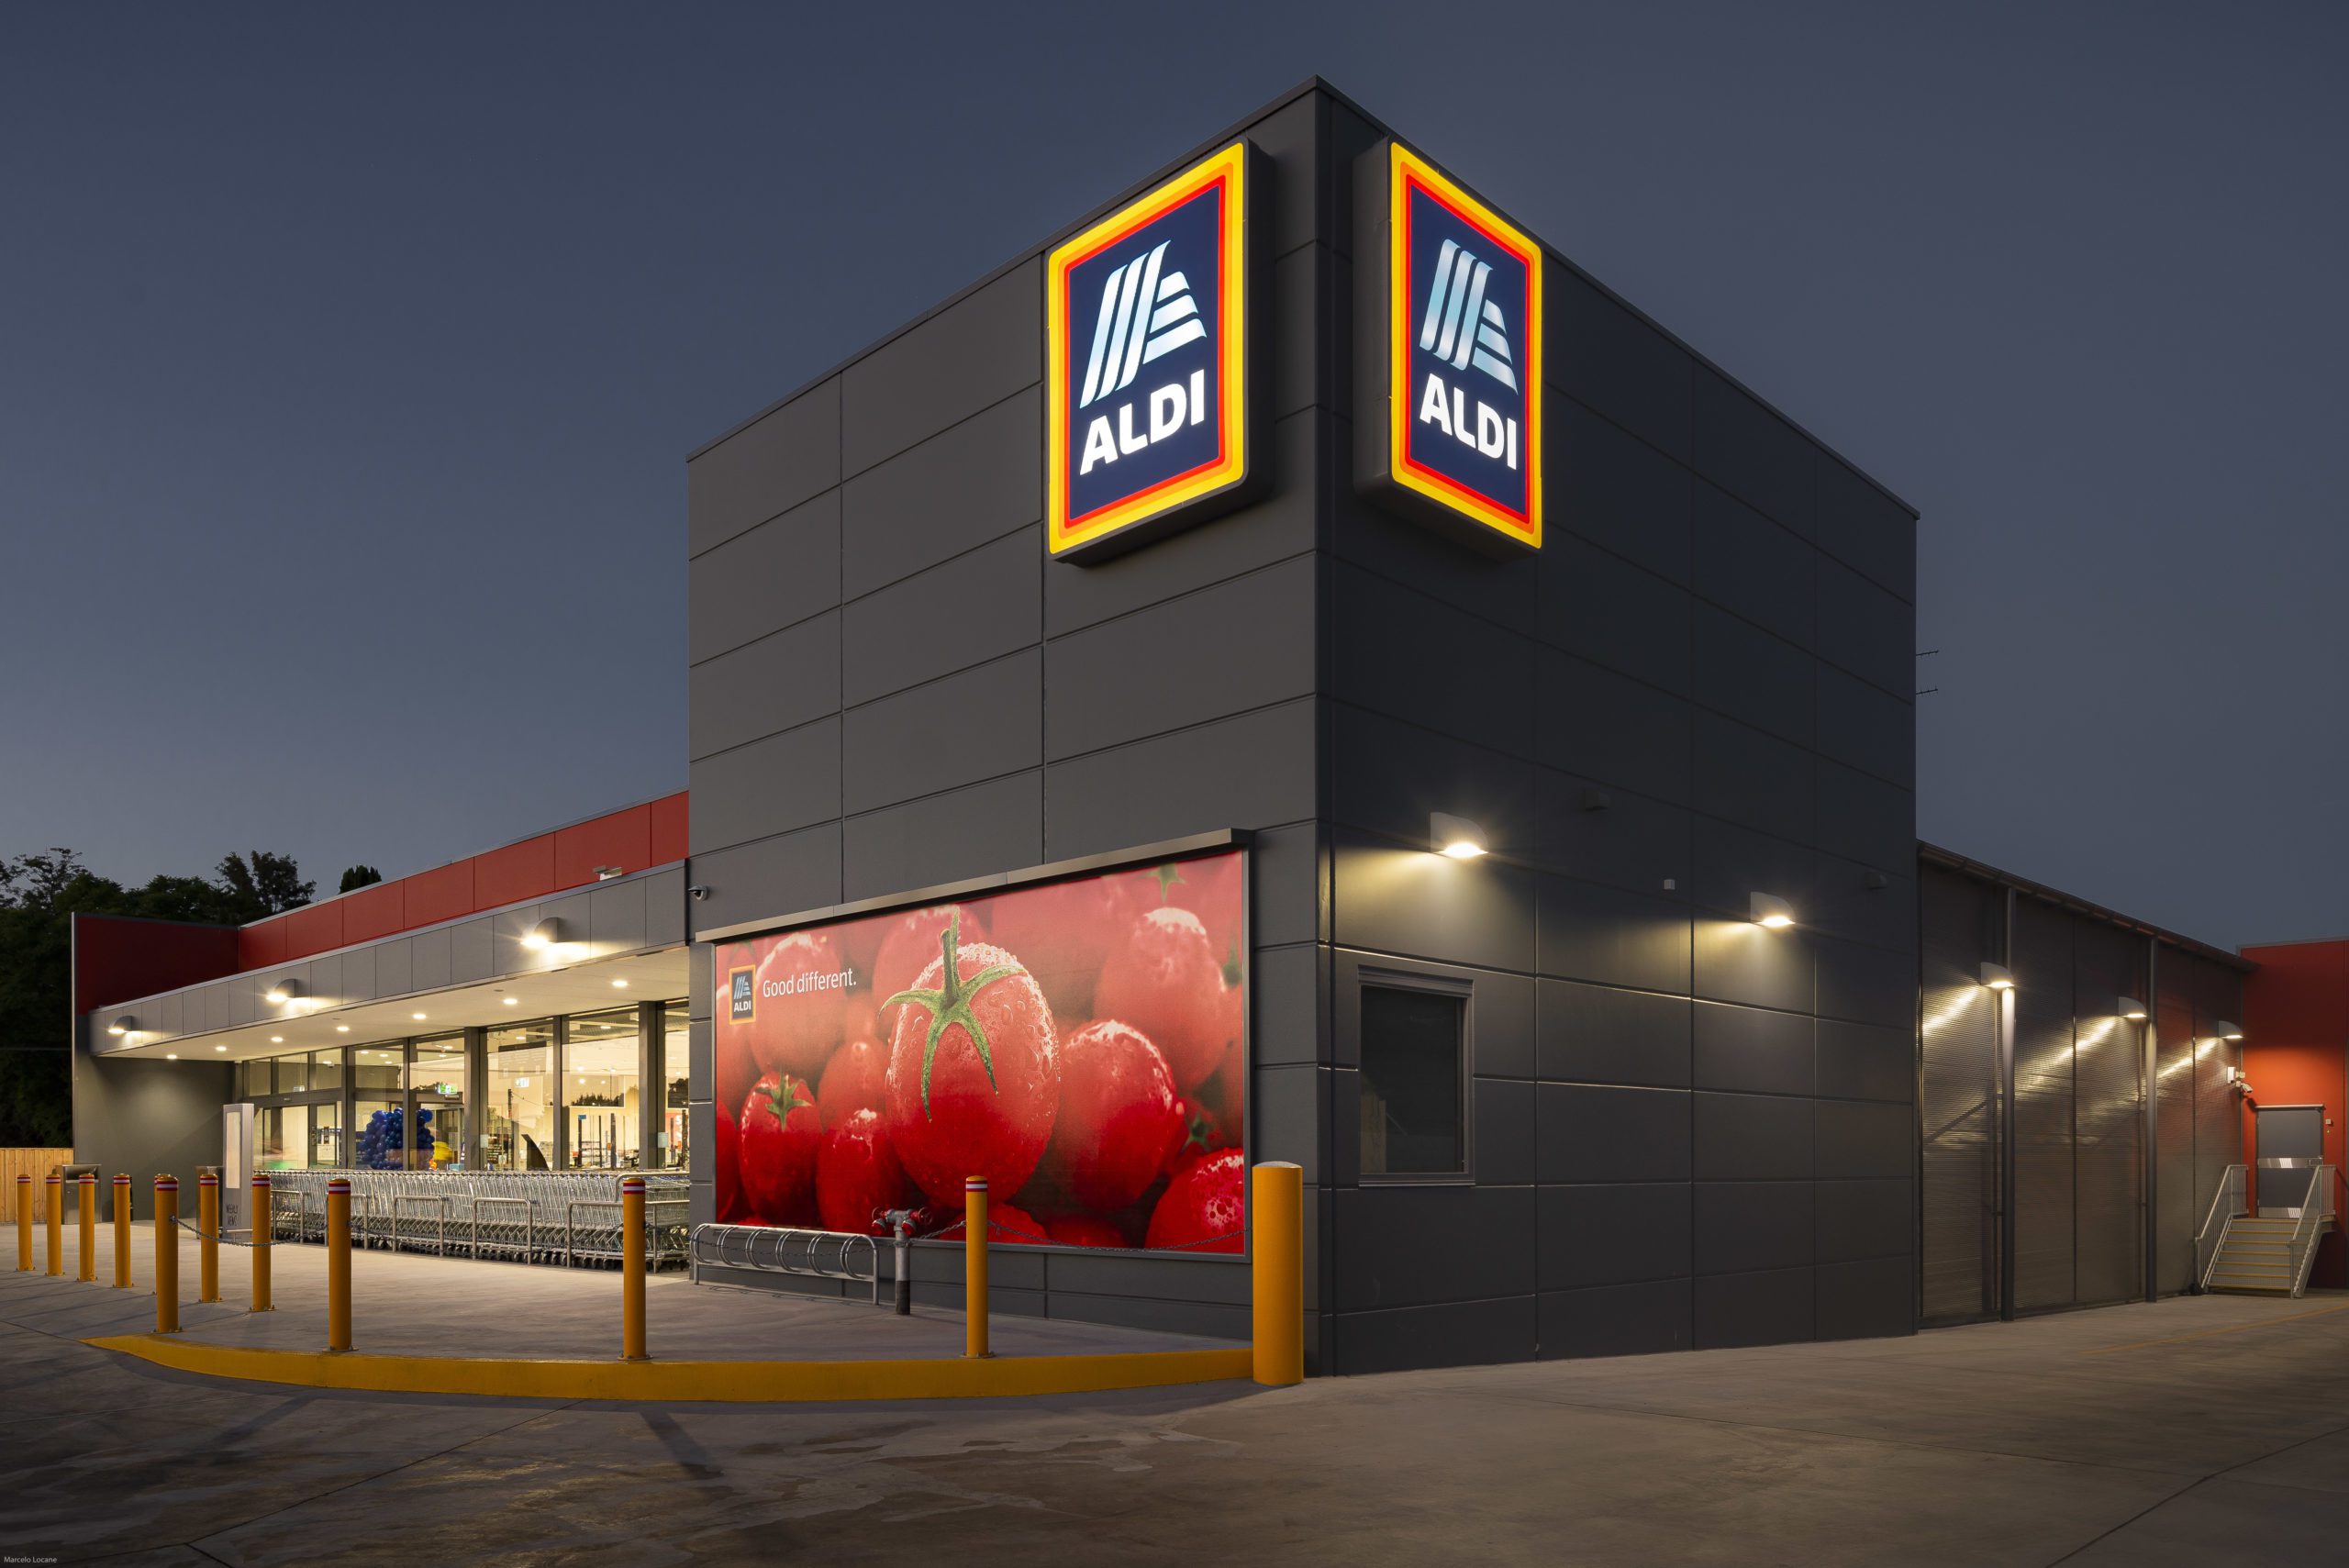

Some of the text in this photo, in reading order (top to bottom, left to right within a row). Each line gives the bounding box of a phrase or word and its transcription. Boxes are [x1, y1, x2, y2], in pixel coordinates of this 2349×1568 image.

[1080, 370, 1205, 475] ALDI
[1419, 373, 1517, 470] ALDI
[734, 1000, 751, 1012] ALDI
[763, 968, 856, 998] Good different.
